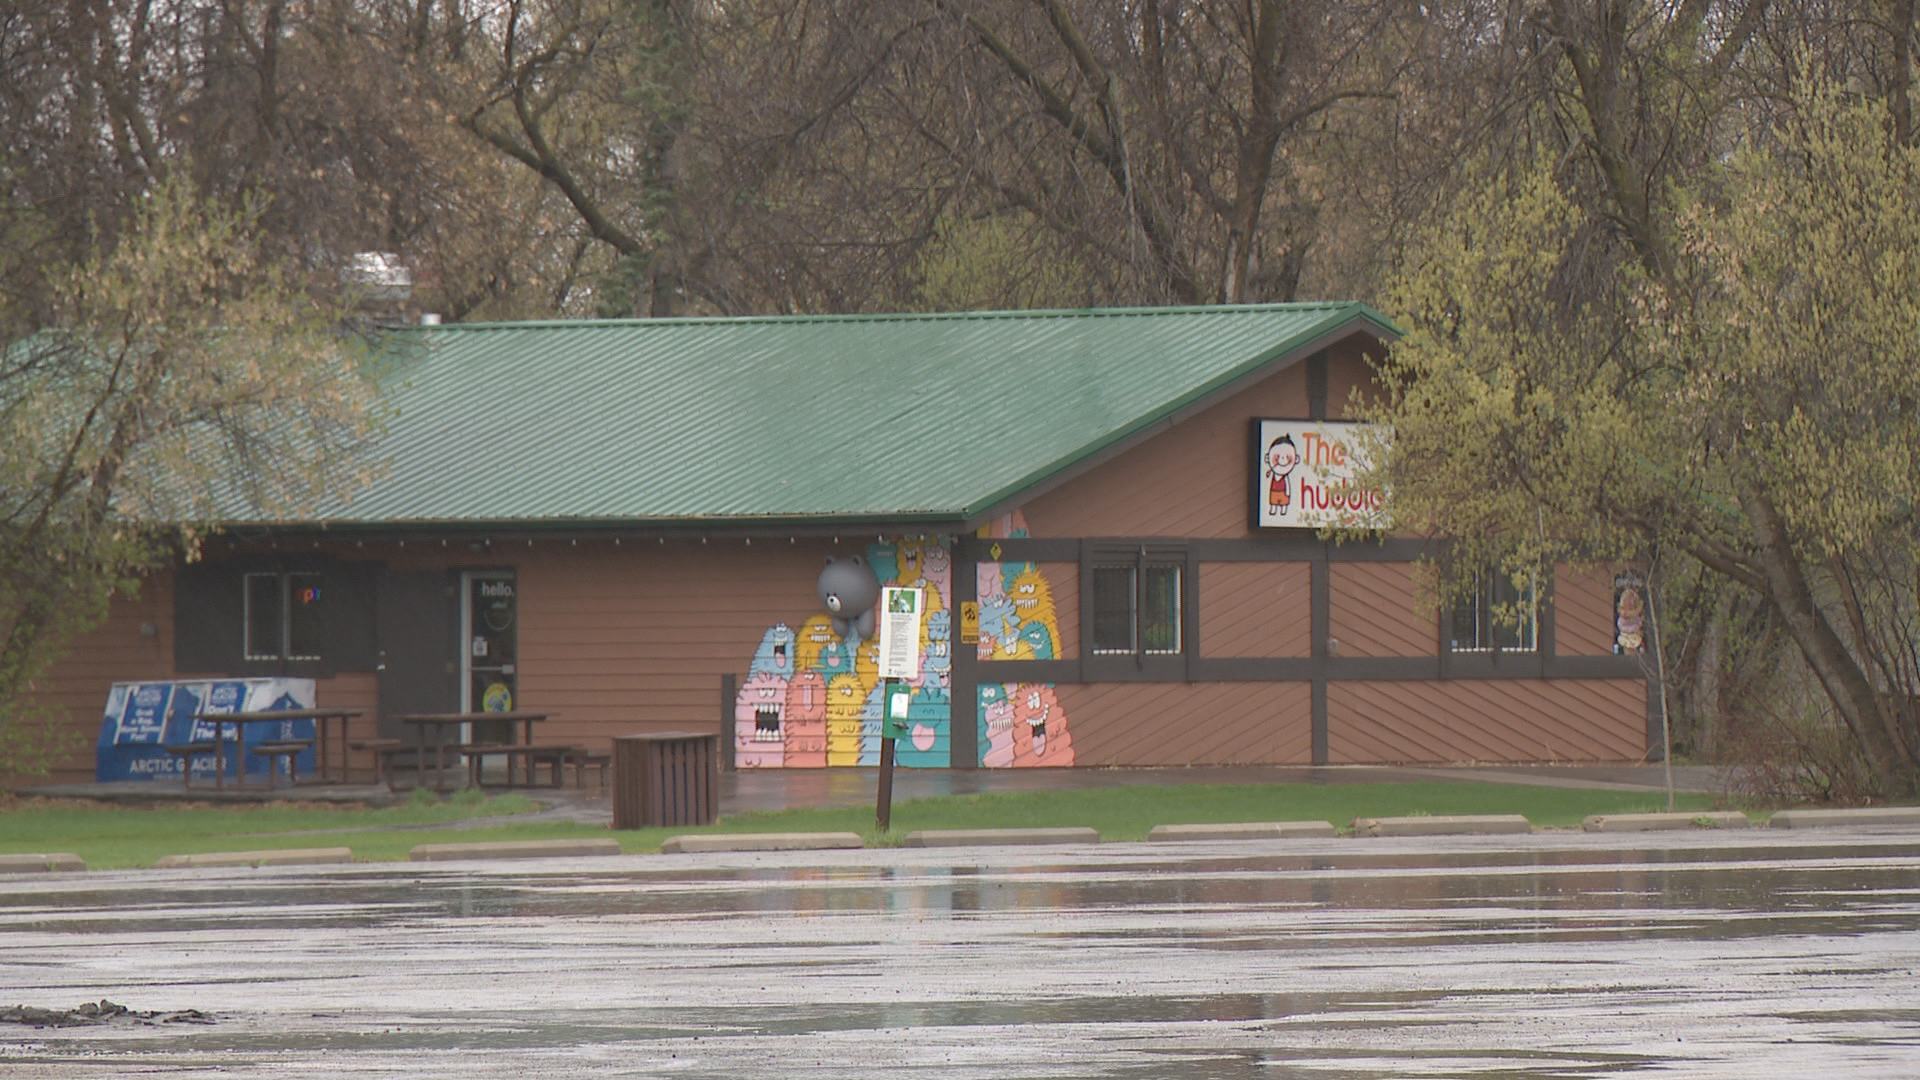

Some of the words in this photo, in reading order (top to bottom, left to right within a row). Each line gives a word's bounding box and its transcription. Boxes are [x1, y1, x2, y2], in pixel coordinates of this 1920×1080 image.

[1302, 432, 1347, 466] The
[482, 581, 515, 597] hello.
[130, 757, 174, 773] ARCTIC
[175, 756, 227, 772] GACIER
